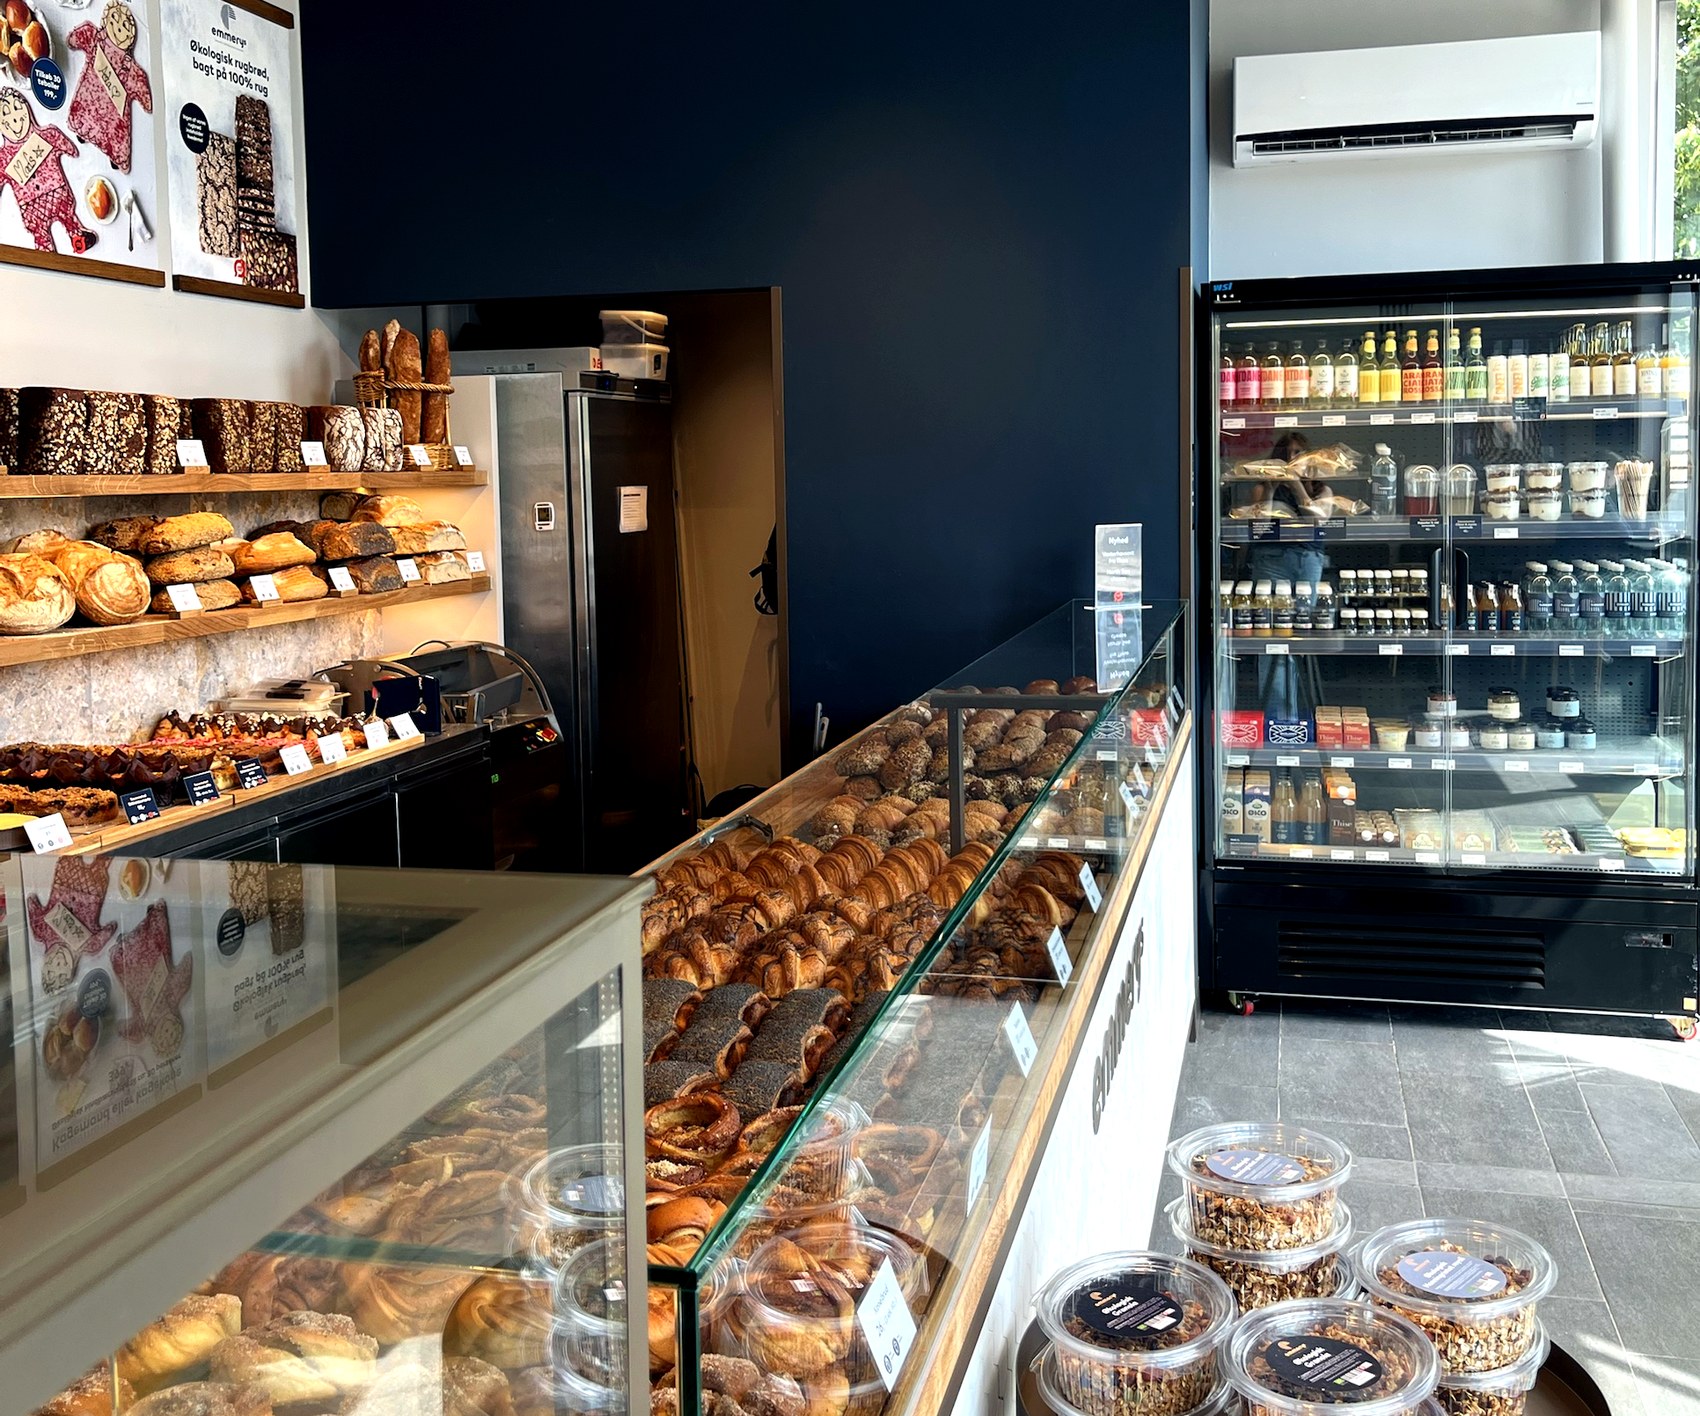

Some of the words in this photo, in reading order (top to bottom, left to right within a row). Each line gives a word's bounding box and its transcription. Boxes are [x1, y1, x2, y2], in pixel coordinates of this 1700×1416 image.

[190, 40, 233, 66] Økologisk
[234, 58, 269, 81] rugbrød,
[192, 57, 214, 76] bagt
[216, 67, 227, 80] på
[229, 71, 253, 90] 100%
[254, 83, 268, 97] rug
[1108, 536, 1129, 546] Nyhed
[1332, 820, 1353, 828] Thise
